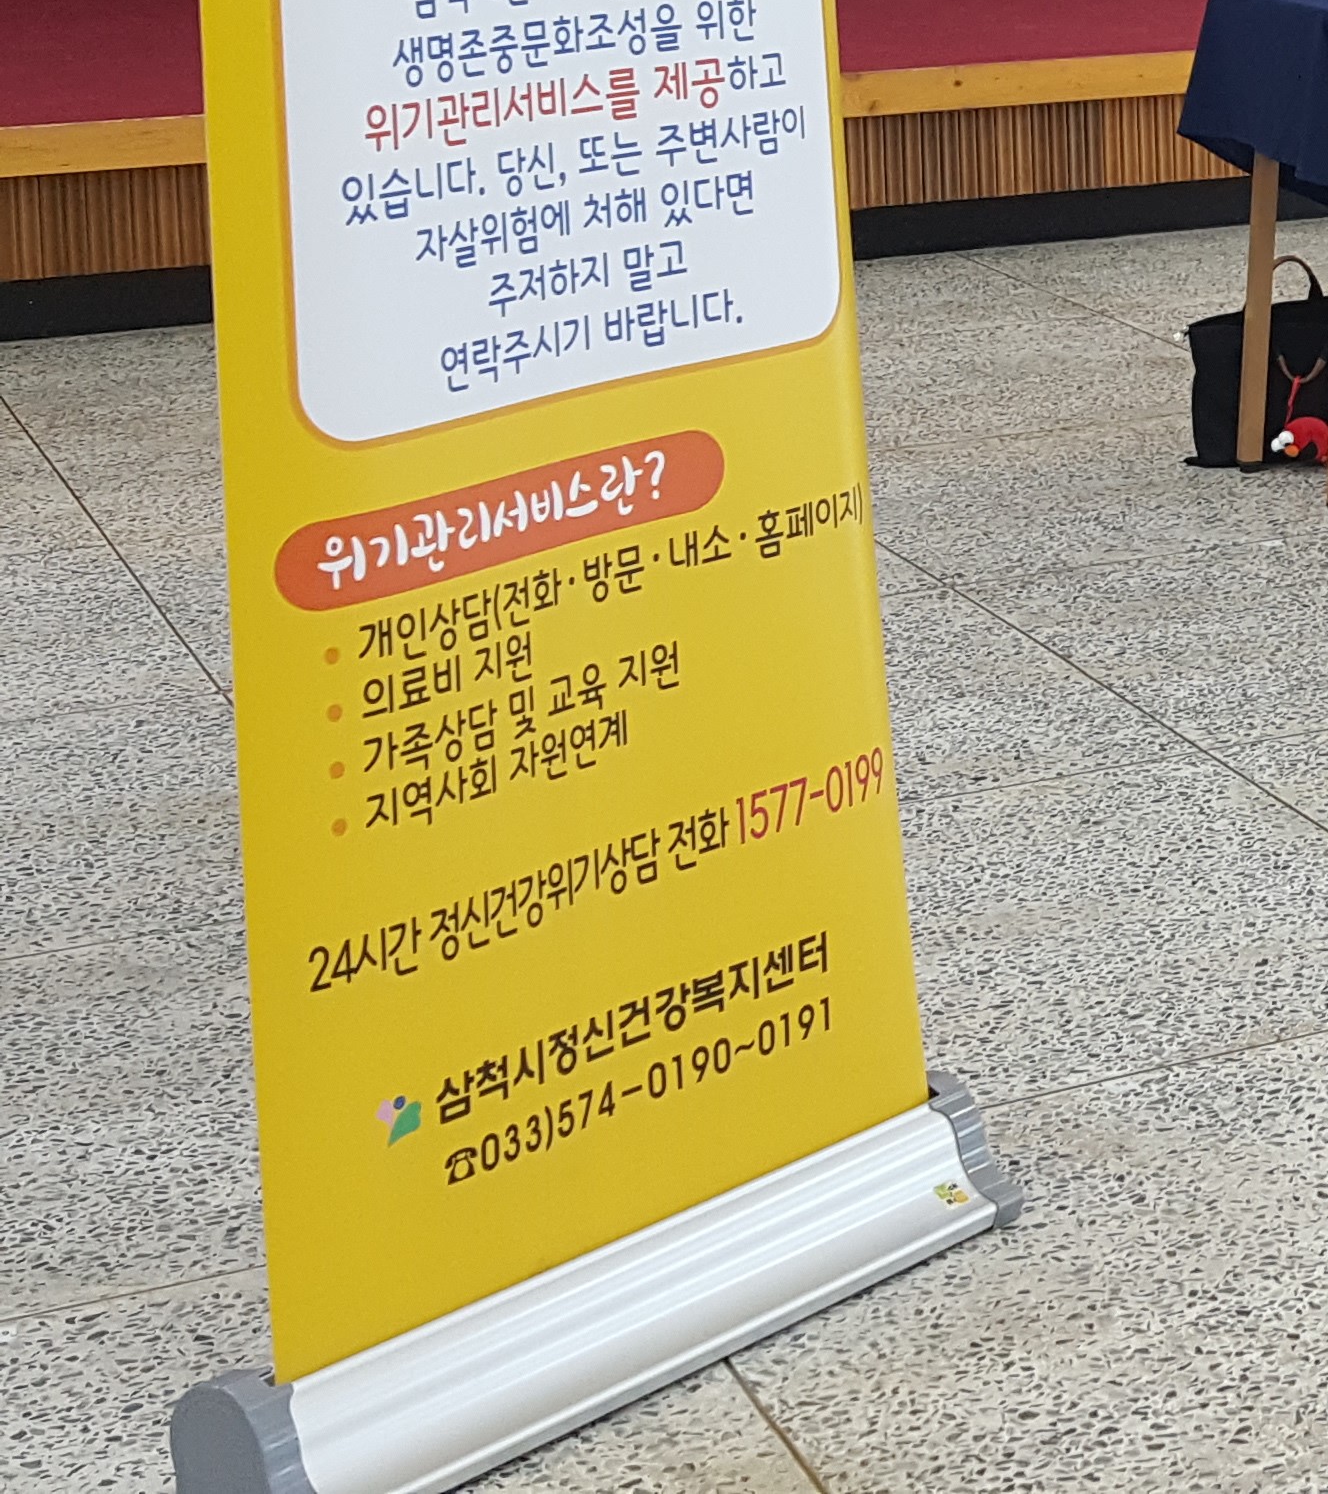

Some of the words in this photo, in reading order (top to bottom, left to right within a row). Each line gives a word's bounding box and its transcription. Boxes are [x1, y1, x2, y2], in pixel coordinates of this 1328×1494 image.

[391, 4, 682, 88] 생명존중문화조성을
[364, 66, 641, 153] 위기관리서비스를
[653, 53, 787, 110] 제공하고
[341, 159, 487, 226] 있습니다.
[497, 141, 567, 196] 당신,
[577, 132, 643, 177] 또는
[655, 106, 806, 169] 주변사람이
[415, 198, 571, 270] 자살위험에
[583, 184, 648, 231] 처해
[659, 168, 755, 228] 있다면
[487, 251, 610, 317] 주저하지
[622, 238, 689, 293] 말고
[440, 312, 591, 393] 연락주시기
[602, 286, 745, 349] 바랍니다.
[315, 450, 667, 590] 위기관리서비스란?
[361, 649, 463, 720] 의료비
[473, 630, 534, 683] 지원
[361, 703, 498, 774] 가족상담
[508, 686, 537, 738] 및
[547, 662, 608, 717] 교육
[617, 640, 681, 691] 지원
[364, 756, 498, 831] 지역사회
[508, 708, 630, 784] 자원연계
[307, 916, 423, 994] 24시간
[428, 827, 661, 963] 정신건강위기상담
[666, 805, 730, 873] 전화
[735, 746, 885, 846] 1577-0199
[435, 930, 831, 1125] 삼척시정신건강복지센터
